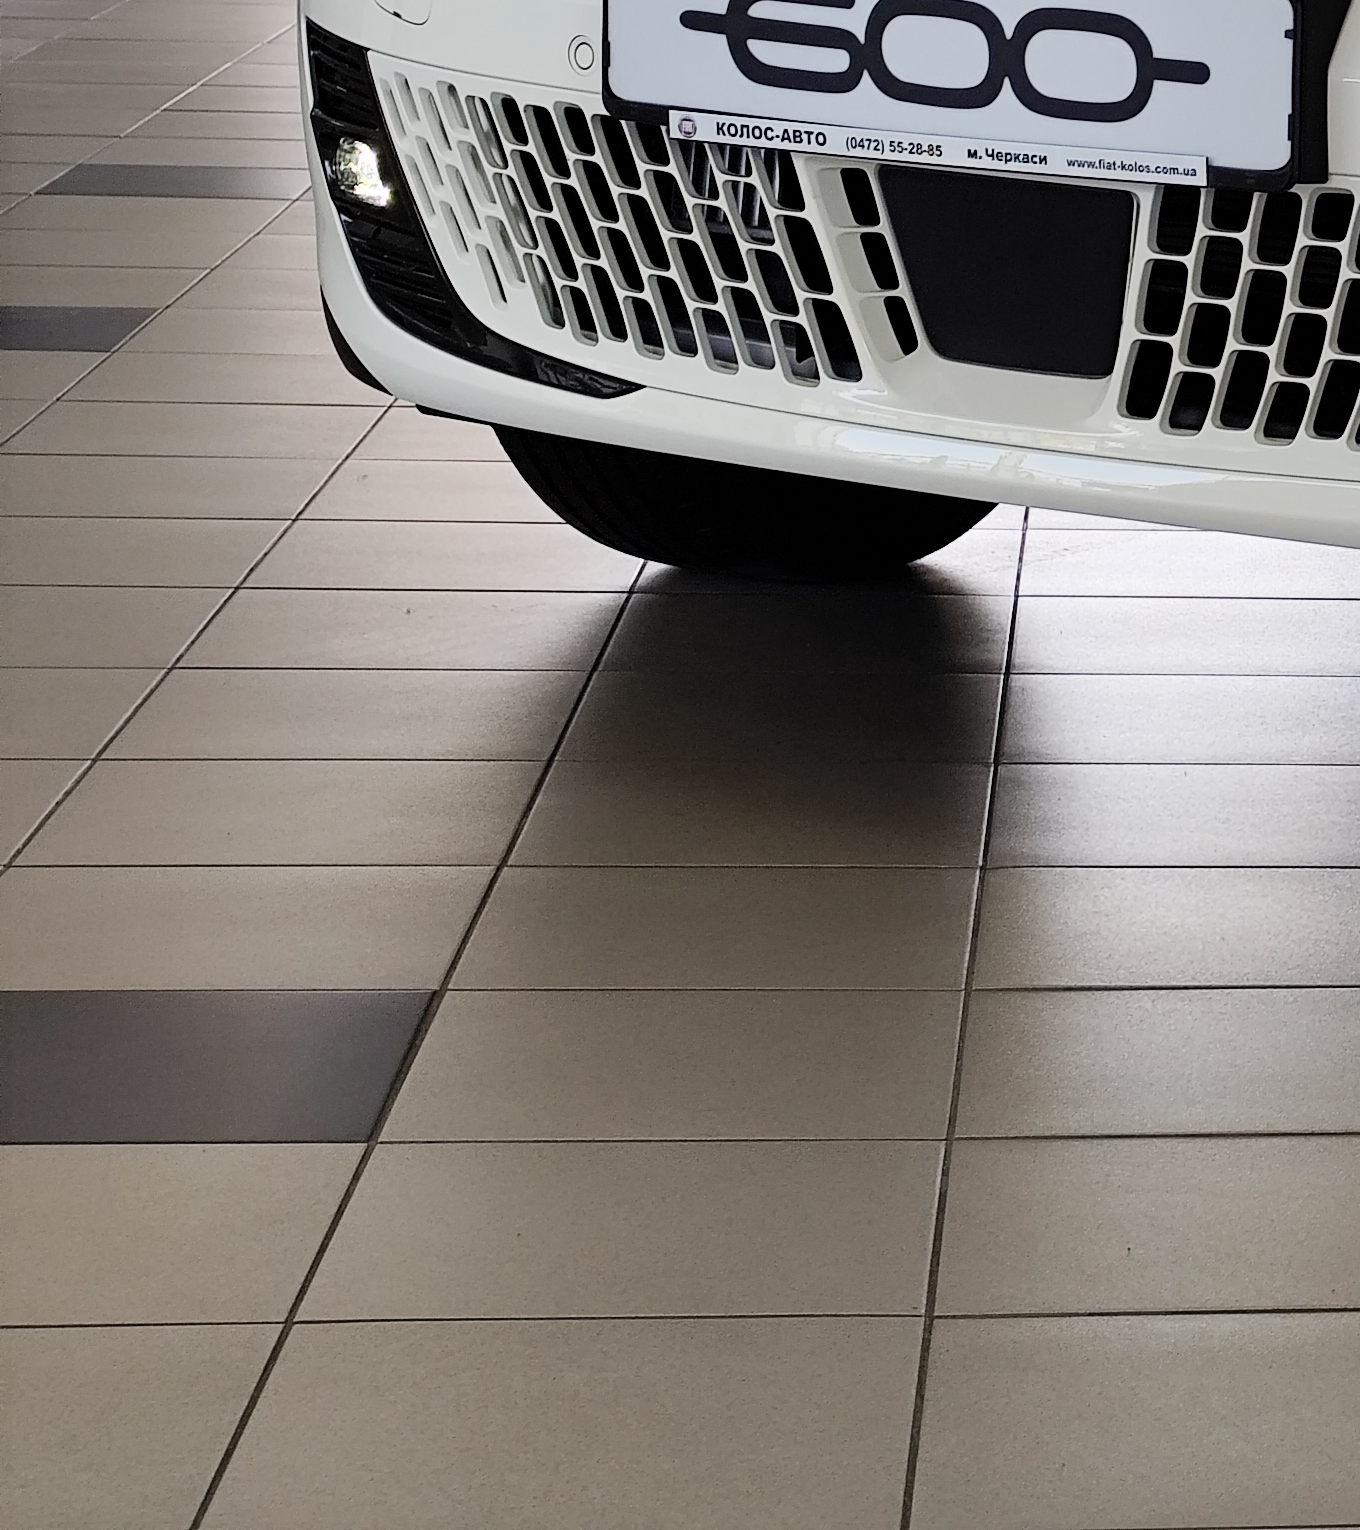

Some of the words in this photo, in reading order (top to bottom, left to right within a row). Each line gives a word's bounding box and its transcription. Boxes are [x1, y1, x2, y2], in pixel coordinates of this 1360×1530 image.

[715, 121, 828, 147] КОЛОС-АВТО
[845, 135, 886, 156] (0472)
[889, 140, 943, 158] 55-28-85
[1066, 157, 1197, 178] www.fiat-kolos.com.ua
